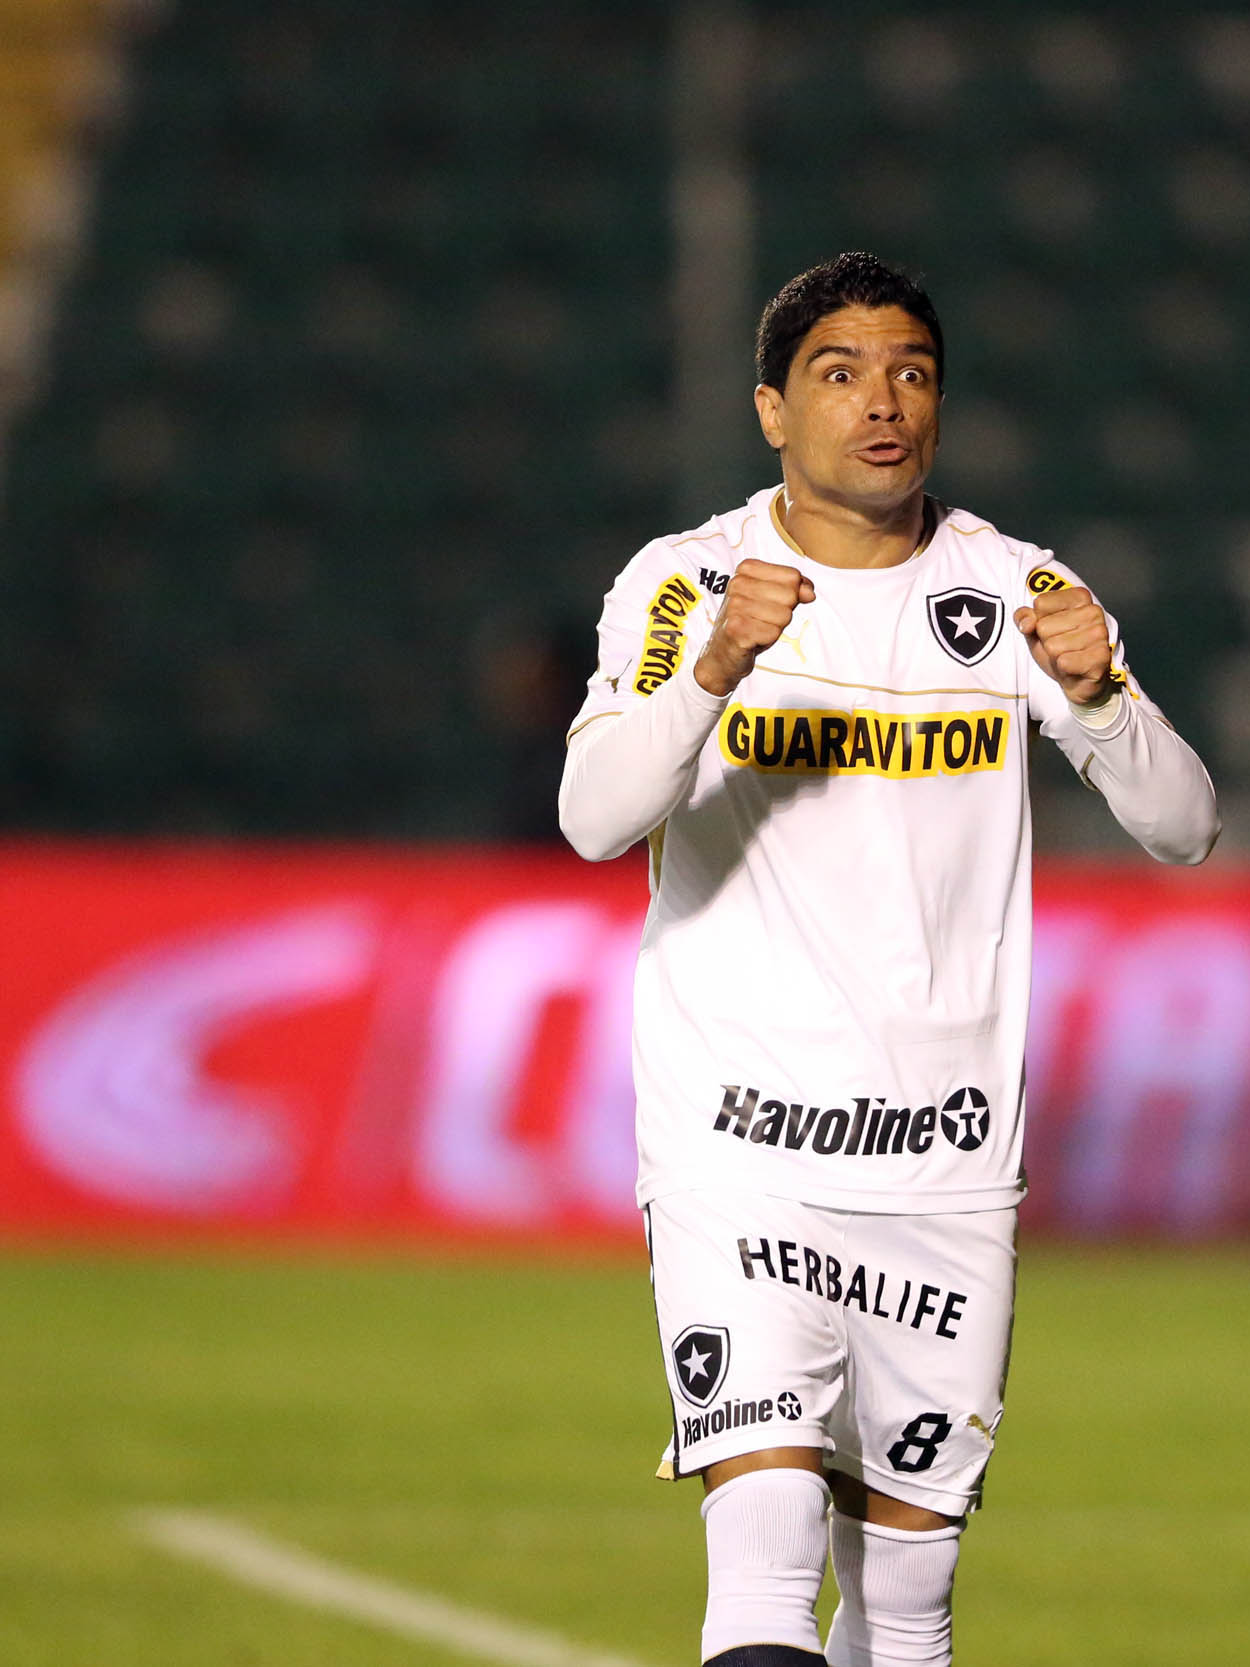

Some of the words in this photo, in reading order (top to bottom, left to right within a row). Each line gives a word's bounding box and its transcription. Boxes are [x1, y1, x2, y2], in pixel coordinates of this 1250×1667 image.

[725, 709, 1004, 772] GUARAVITON
[713, 1084, 937, 1156] Havoline
[737, 1238, 968, 1340] HERBALIFE
[682, 1398, 773, 1449] Havoline
[886, 1412, 953, 1474] 8
